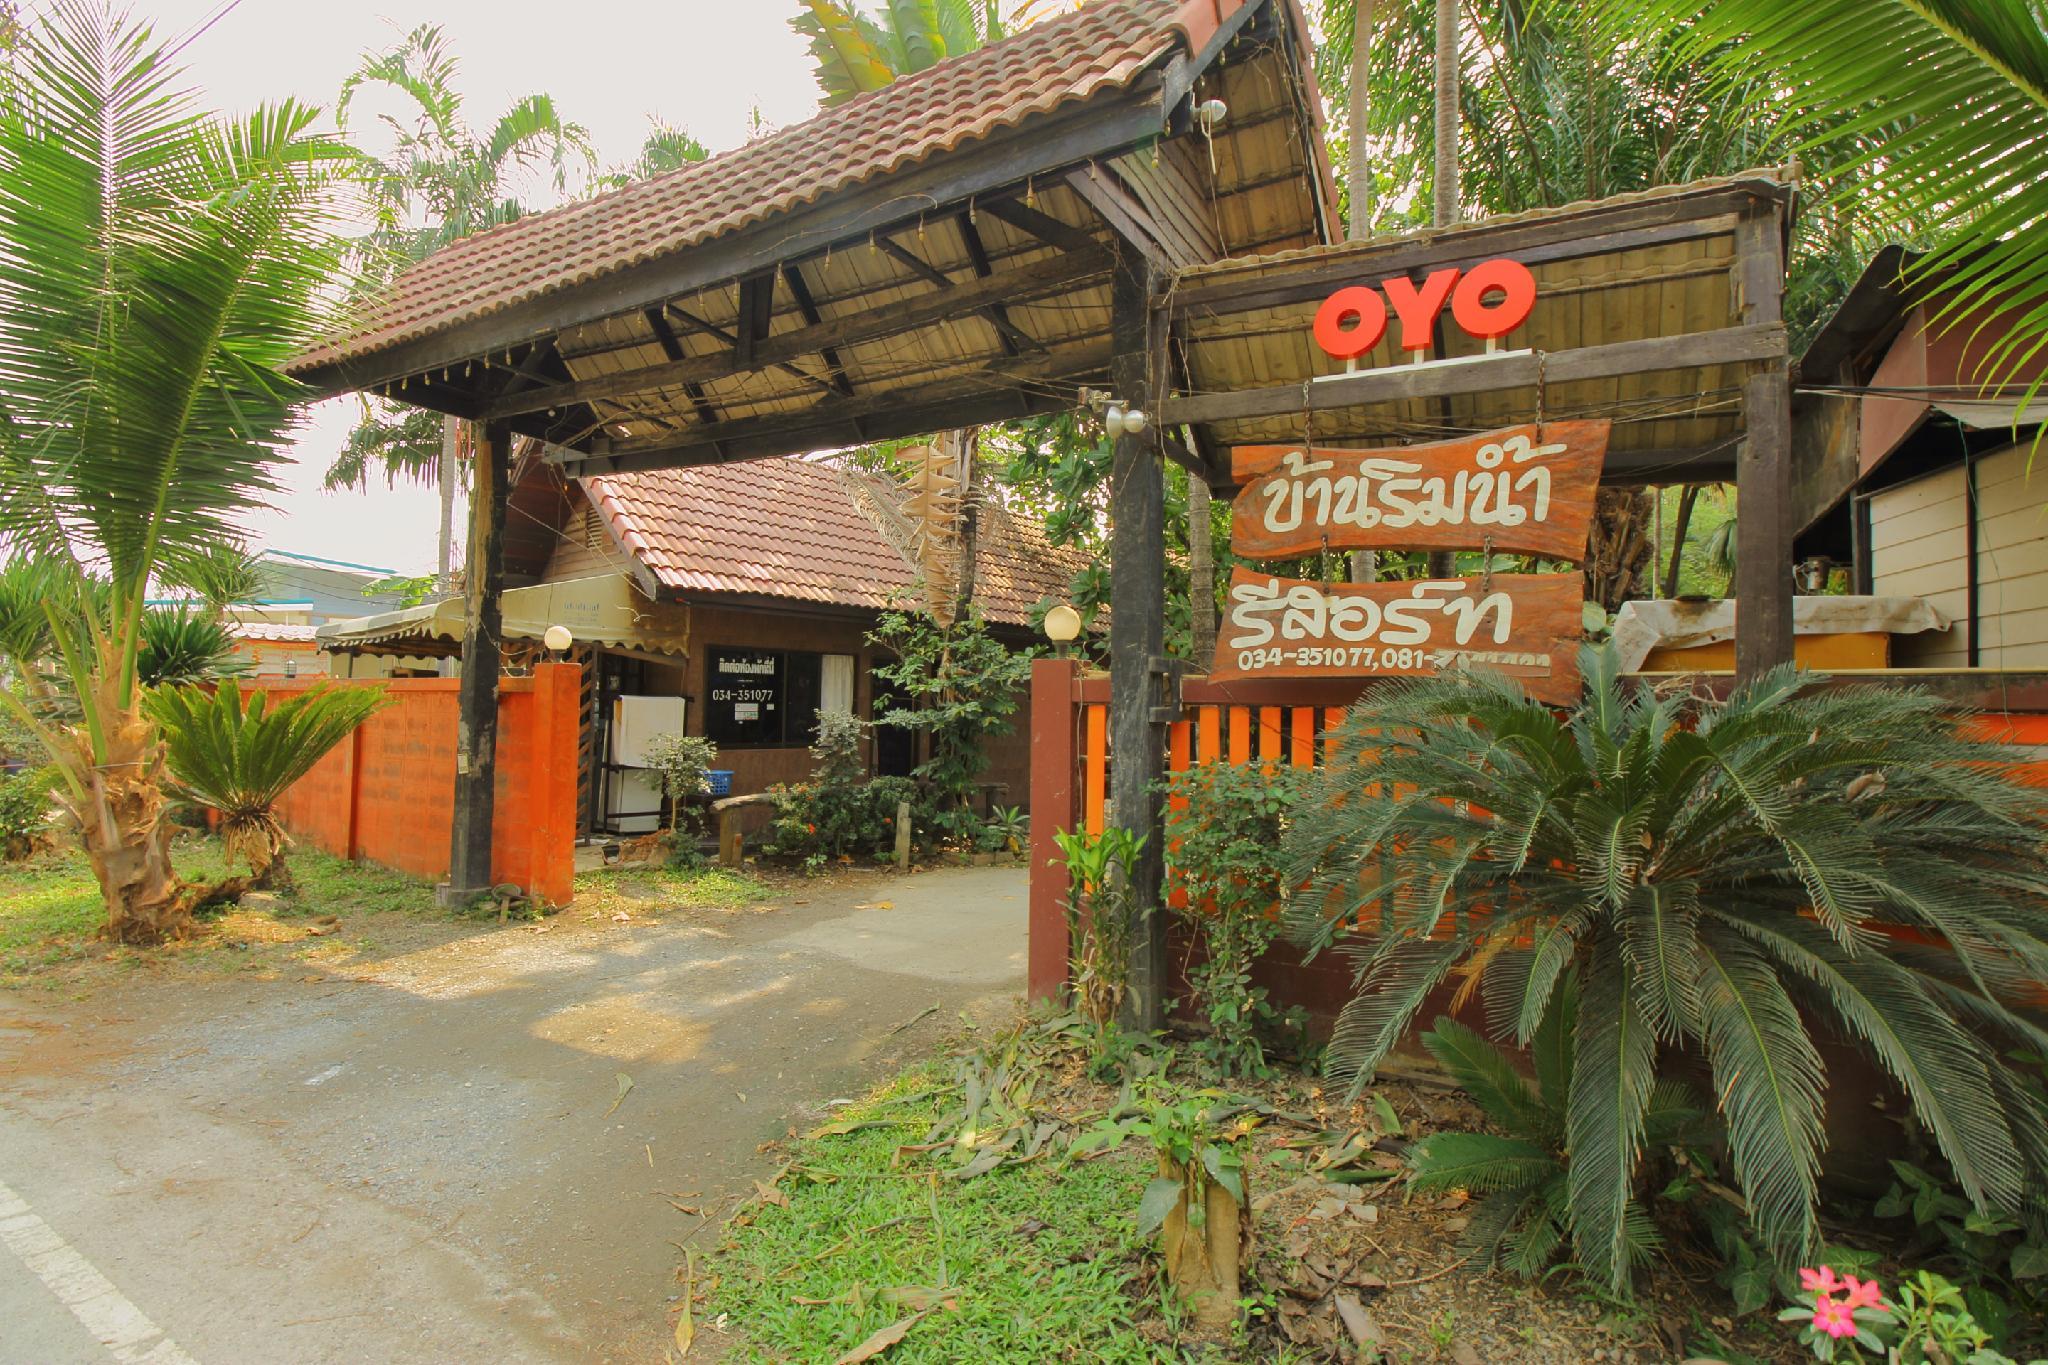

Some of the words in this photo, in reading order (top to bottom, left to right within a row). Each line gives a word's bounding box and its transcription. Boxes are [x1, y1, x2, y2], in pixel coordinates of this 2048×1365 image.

[1313, 259, 1536, 361] OYO
[1263, 435, 1567, 533] บ้านริมน้ำ
[1230, 579, 1513, 649] รีสอร์ท
[712, 689, 773, 702] 034-351077
